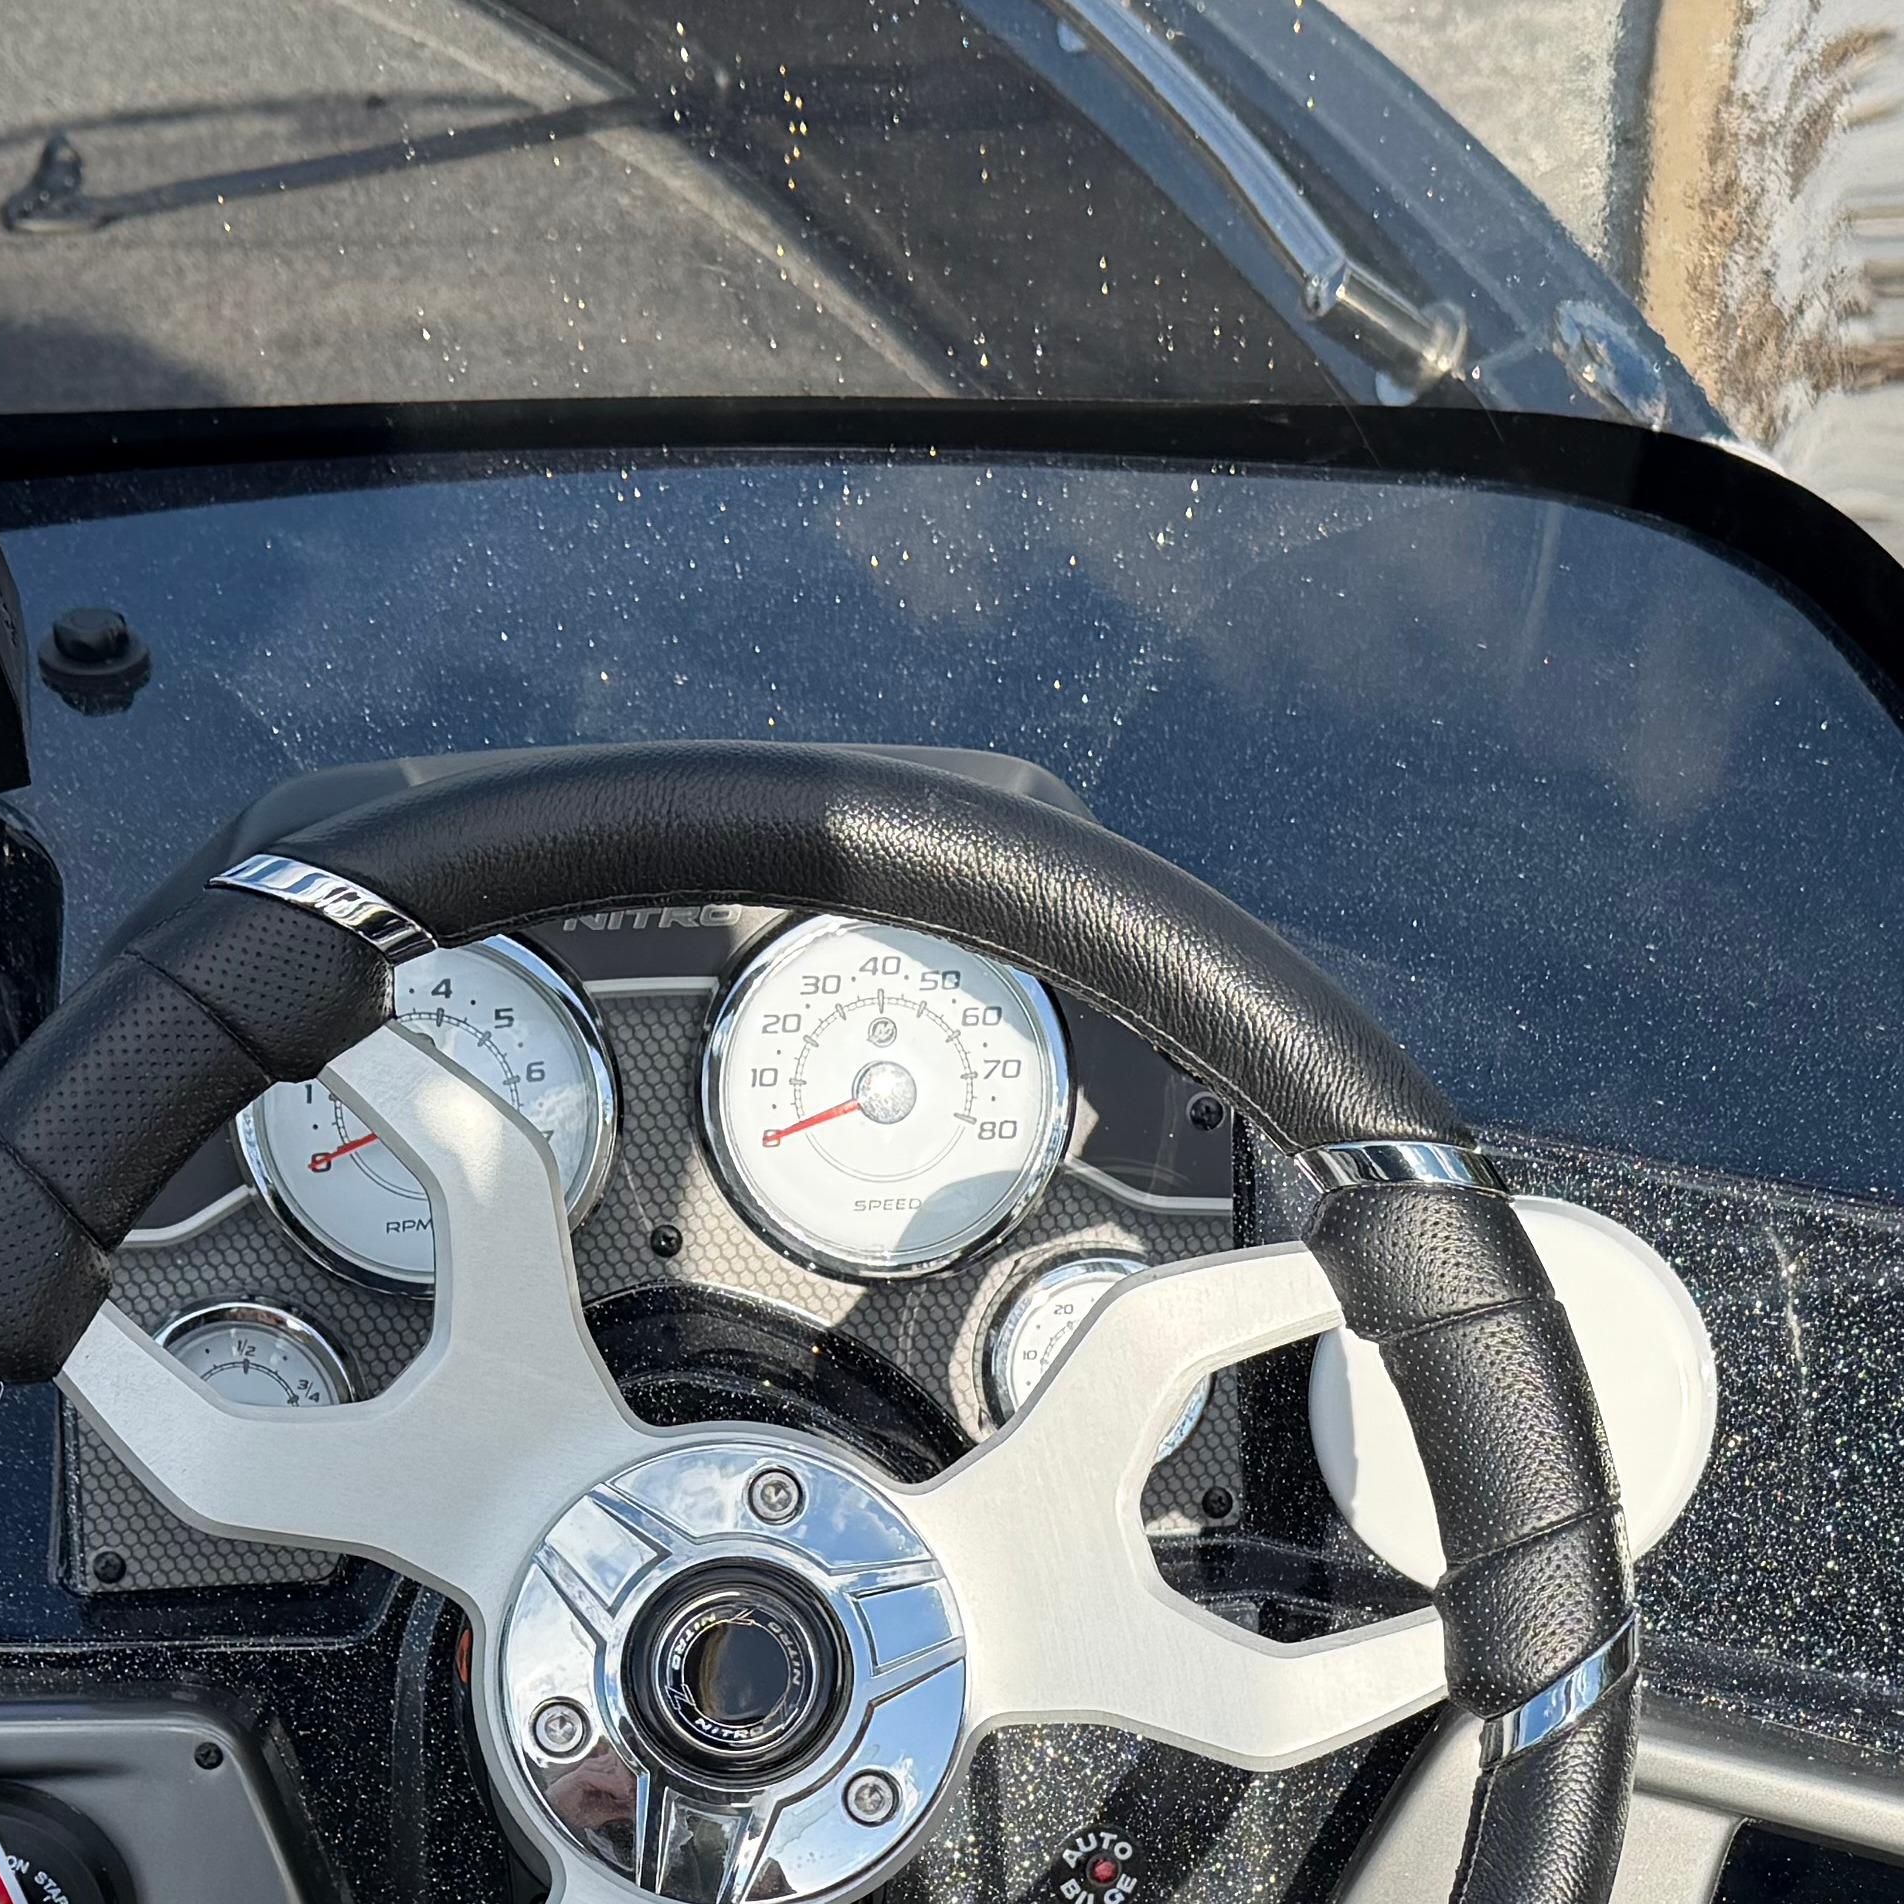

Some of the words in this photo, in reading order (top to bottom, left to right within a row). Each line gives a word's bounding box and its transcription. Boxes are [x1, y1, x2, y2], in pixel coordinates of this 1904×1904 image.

[563, 904, 742, 931] NITRO
[859, 956, 901, 976] 40
[431, 978, 453, 999] 4
[800, 975, 842, 995] 30
[919, 971, 961, 991] 50
[494, 1008, 514, 1028] 5
[761, 1014, 802, 1034] 20
[961, 1006, 1003, 1027] 60
[526, 1061, 546, 1082] 6
[750, 1068, 778, 1087] 10
[983, 1060, 1021, 1079] 70
[304, 1084, 313, 1104] 1
[978, 1120, 1018, 1140] 80
[853, 1198, 922, 1211] SPEED
[386, 1218, 433, 1235] RPM
[1054, 1304, 1074, 1315] 20
[237, 1339, 256, 1357] 1/2
[1023, 1349, 1037, 1361] 10
[298, 1379, 320, 1403] 3/4
[671, 1613, 716, 1670] NITRO
[695, 1718, 764, 1739] NITRO
[1062, 1832, 1133, 1868] AUTO
[6, 1855, 30, 1874] ON
